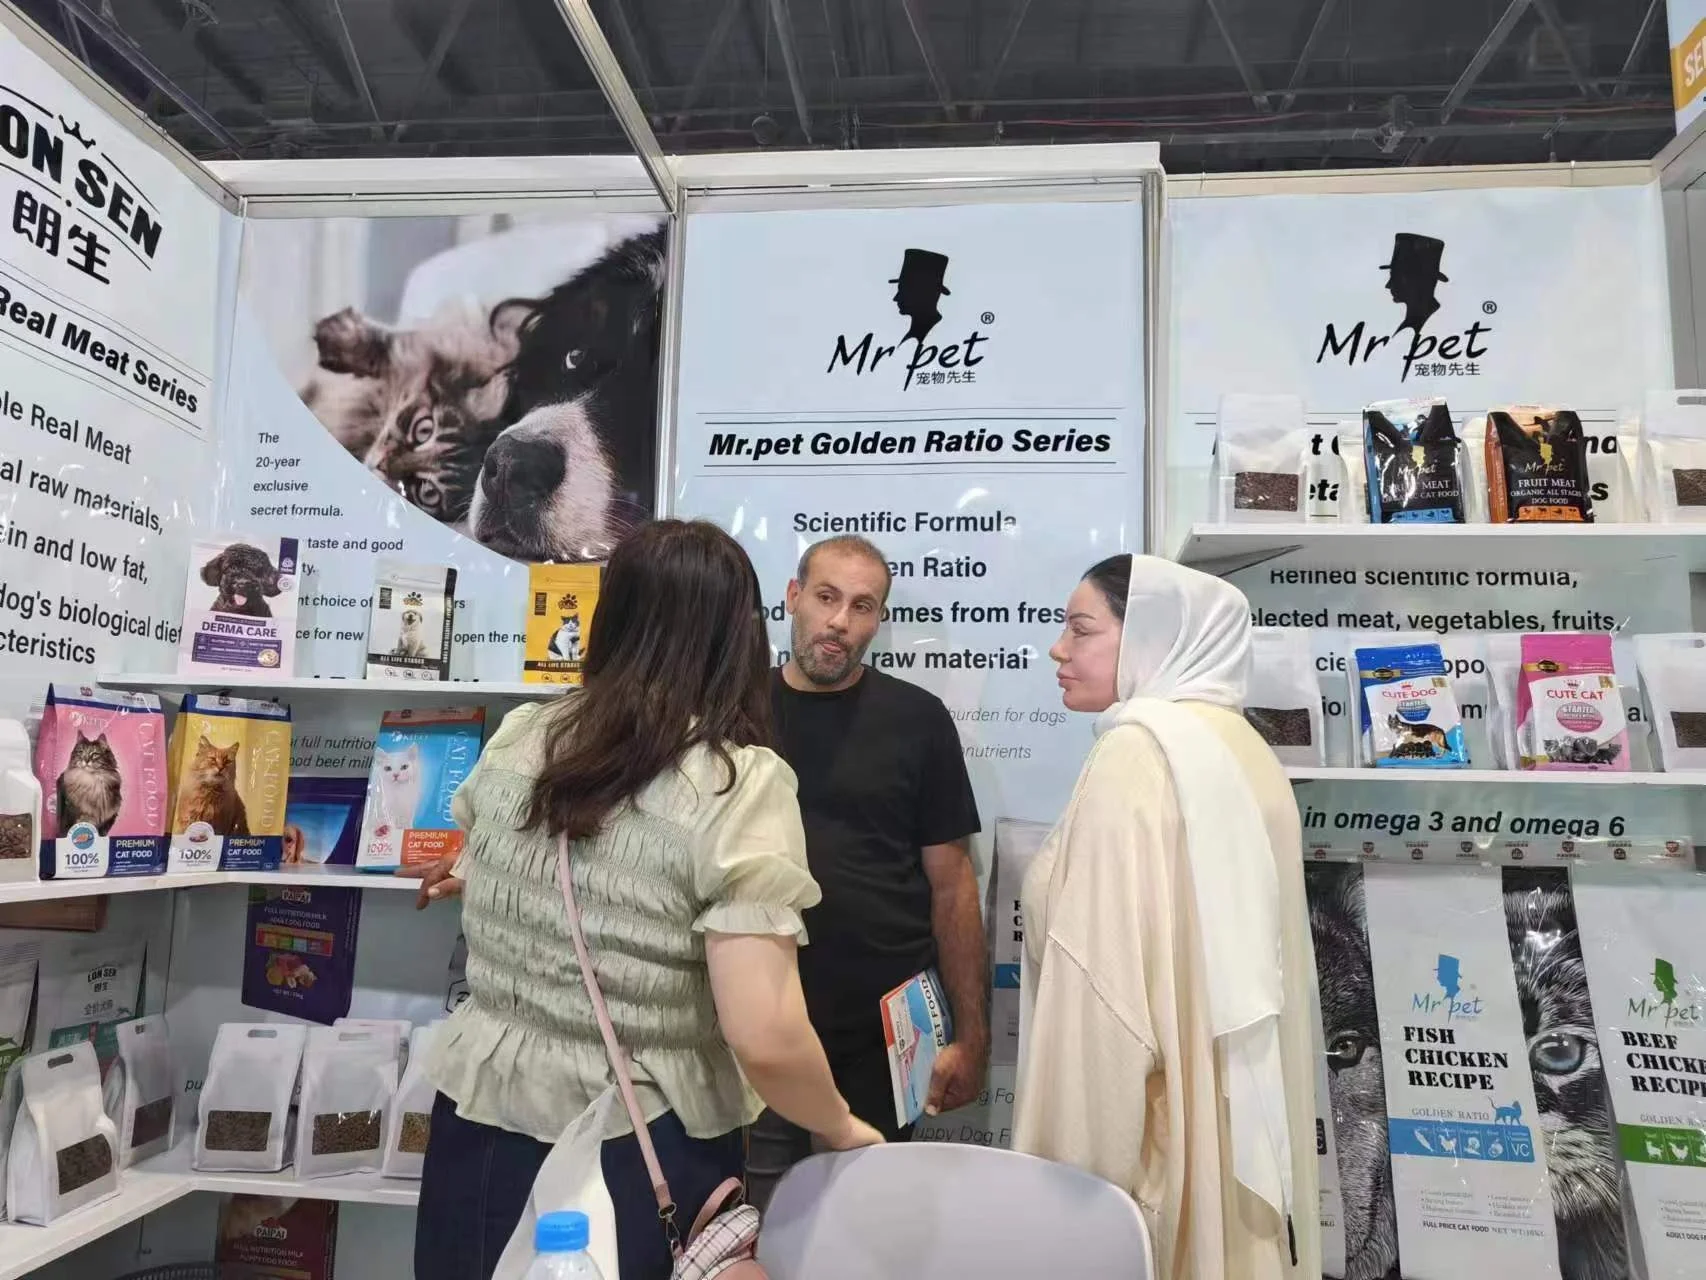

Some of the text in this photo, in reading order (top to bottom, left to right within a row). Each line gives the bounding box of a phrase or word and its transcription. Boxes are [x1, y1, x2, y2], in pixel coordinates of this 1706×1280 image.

[1684, 36, 1706, 88] SE
[75, 158, 163, 259] SEN
[12, 190, 111, 285] 朗生
[0, 286, 198, 413] Real Meat Series
[1414, 361, 1482, 377] 宠物先生
[916, 370, 977, 385] 宠物先生
[0, 390, 132, 465] le Real Meat
[258, 432, 280, 444] The
[709, 428, 1111, 460] Mr.pet Golden Ratio Series
[255, 456, 301, 471] 20-year
[253, 480, 309, 492] exclusive
[1518, 479, 1576, 488] FRUIT MEAT
[29, 470, 69, 499] raw
[73, 487, 164, 536] materials,
[250, 504, 344, 517] secret formula.
[793, 510, 1017, 533] Scientific Formula
[307, 537, 404, 553] taste and good
[34, 535, 149, 585] and low fat,
[923, 556, 987, 578] Ratio
[313, 595, 357, 607] choice
[58, 596, 151, 638] biological
[951, 601, 1009, 623] from
[201, 621, 278, 638] DERMA CARE
[1337, 611, 1401, 631] meat,
[1407, 610, 1545, 635] vegetables,
[1552, 610, 1621, 631] fruits,
[314, 627, 333, 640] for
[336, 631, 365, 641] new
[454, 632, 485, 646] open
[488, 630, 509, 643] the
[871, 648, 1029, 670] raw material
[1411, 688, 1437, 698] DOG
[1546, 689, 1604, 700] CUTE CAT
[948, 707, 1067, 726] burden for dogs
[301, 736, 321, 748] full
[316, 755, 345, 768] beef
[1303, 806, 1626, 837] in omega 3 and omega 6
[116, 839, 155, 848] PREMIUM
[229, 838, 266, 847] PREMIUM
[408, 831, 449, 840] PREMIUM
[227, 848, 262, 857] CAT FOOD
[407, 841, 444, 849] CAT FOOD
[65, 852, 99, 866] 100%
[115, 850, 153, 859] CAT FOOD
[179, 849, 212, 860] 100%
[921, 977, 945, 1048] PET FOOD
[1403, 1026, 1456, 1045] FISH
[1620, 1030, 1678, 1050] BEEF
[1405, 1049, 1509, 1069] CHICKEN
[1408, 1070, 1495, 1090] RECIPE
[1411, 1107, 1490, 1121] GOLDEN RATIO
[960, 1125, 993, 1146] Dog
[1510, 1142, 1530, 1157] VC
[1423, 1221, 1437, 1229] FULL
[1439, 1222, 1457, 1230] PRICE
[1471, 1225, 1489, 1233] FOOD
